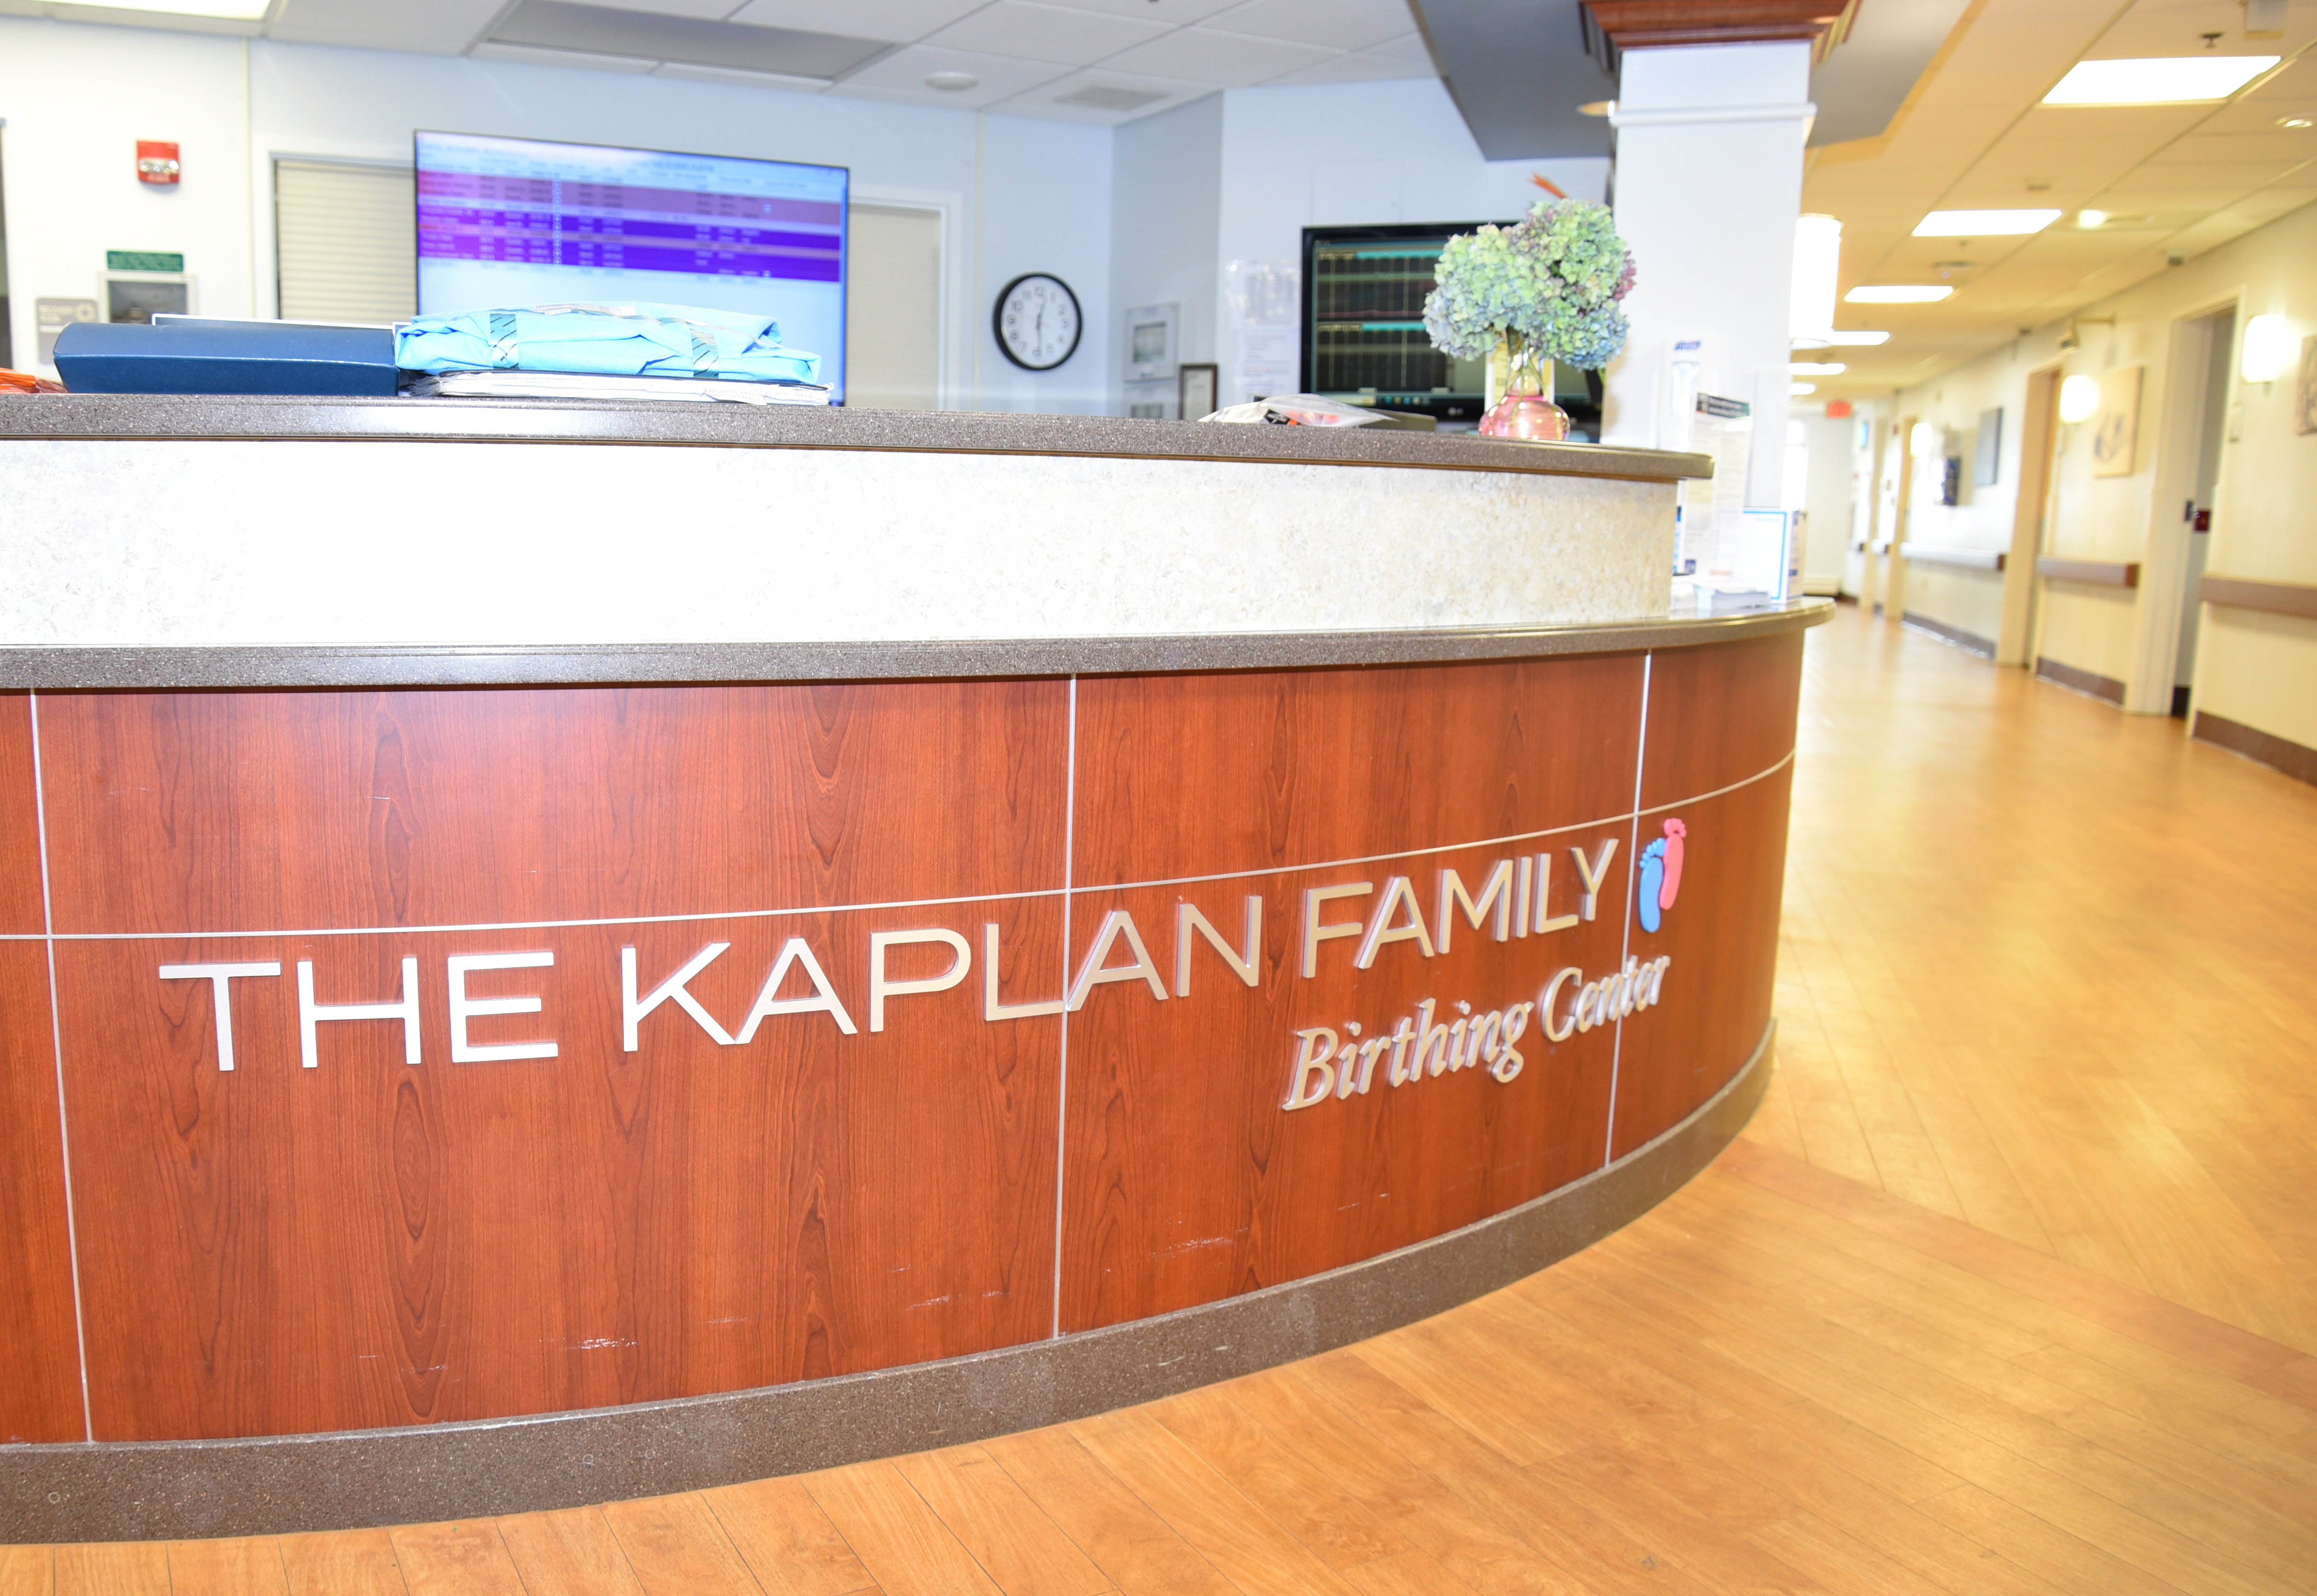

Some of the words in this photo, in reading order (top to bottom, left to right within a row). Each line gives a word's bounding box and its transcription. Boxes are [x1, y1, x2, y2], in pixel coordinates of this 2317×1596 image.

[159, 951, 558, 1071] THE
[621, 895, 1262, 1052] KAPLAN
[1302, 838, 1619, 978] FAMILY
[1282, 997, 1535, 1111] Birthing
[1542, 954, 1671, 1043] Center
